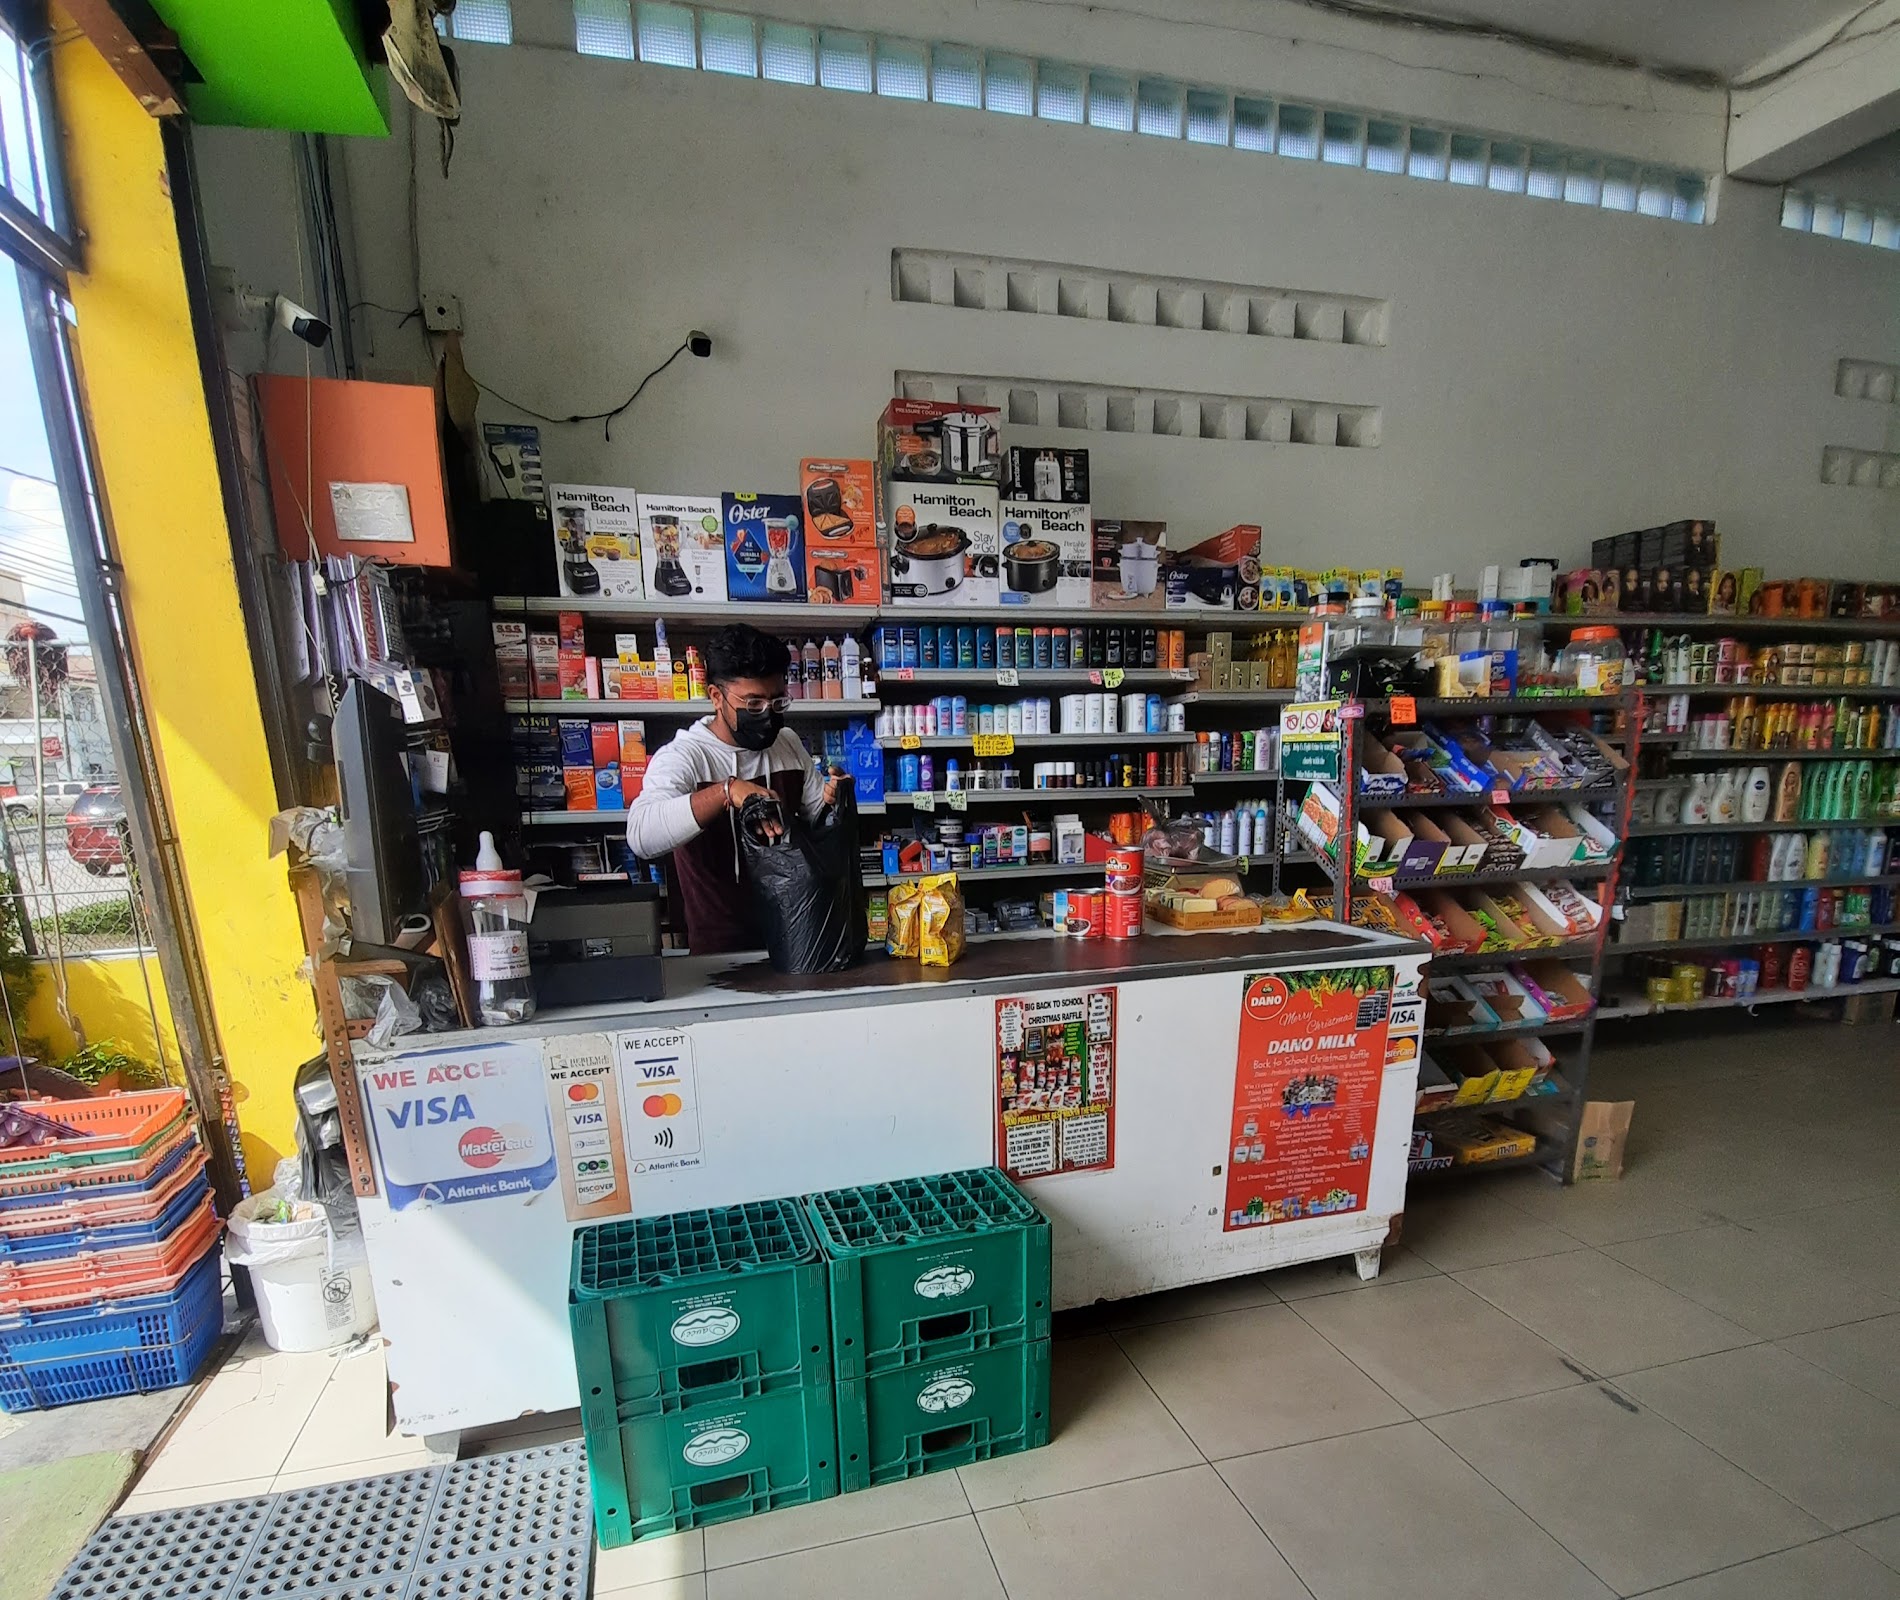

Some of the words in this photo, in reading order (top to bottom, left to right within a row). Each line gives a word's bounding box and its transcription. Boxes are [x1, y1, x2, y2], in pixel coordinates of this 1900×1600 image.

[895, 407, 921, 415] PRESSURE
[557, 491, 614, 503] Hamilton
[913, 493, 976, 506] Hamilton
[591, 502, 631, 513] Beach
[646, 504, 686, 513] Hamilton
[687, 506, 716, 514] Beach
[949, 506, 992, 518] Beach
[1005, 506, 1068, 520] Hamilton
[729, 504, 771, 525] Oster
[1041, 519, 1086, 532] Beach
[973, 531, 995, 544] Stay
[982, 542, 995, 554] Go
[1169, 571, 1189, 581] Oster
[358, 574, 381, 661] MAGNAVOX
[560, 722, 589, 730] Viro-Grip
[541, 765, 555, 773] PM
[1025, 1002, 1035, 1011] BIG
[1036, 1000, 1052, 1009] BACK
[1053, 999, 1061, 1008] TO
[1061, 997, 1084, 1006] SCHOOL
[1250, 995, 1282, 1007] DANO
[1028, 1013, 1061, 1025] CHRISTMAS
[1062, 1011, 1083, 1021] RAFFLE
[1279, 1011, 1313, 1026] Merry
[1306, 1012, 1353, 1034] Christmas
[624, 1039, 641, 1050] WE
[643, 1035, 686, 1048] ACCEPT
[1268, 1036, 1314, 1055] DANO
[1317, 1033, 1358, 1050] MILK
[1253, 1060, 1271, 1069] Back
[1273, 1057, 1282, 1067] to
[1284, 1055, 1308, 1065] School
[1310, 1053, 1347, 1063] Christmas
[1349, 1049, 1370, 1059] Raffle
[372, 1070, 417, 1091] WE
[427, 1061, 505, 1084] ACCE
[551, 1072, 567, 1080] WE
[570, 1067, 611, 1078] ACCEPT
[640, 1065, 676, 1079] VISA
[386, 1094, 475, 1129] VISA
[574, 1112, 603, 1125] VISA
[461, 1135, 535, 1157] MasterCard
[649, 1161, 679, 1172] Atlantic
[680, 1158, 700, 1166] Bank
[447, 1183, 499, 1200] Atlantic
[500, 1177, 532, 1192] Bank
[578, 1183, 614, 1193] DISCOVER
